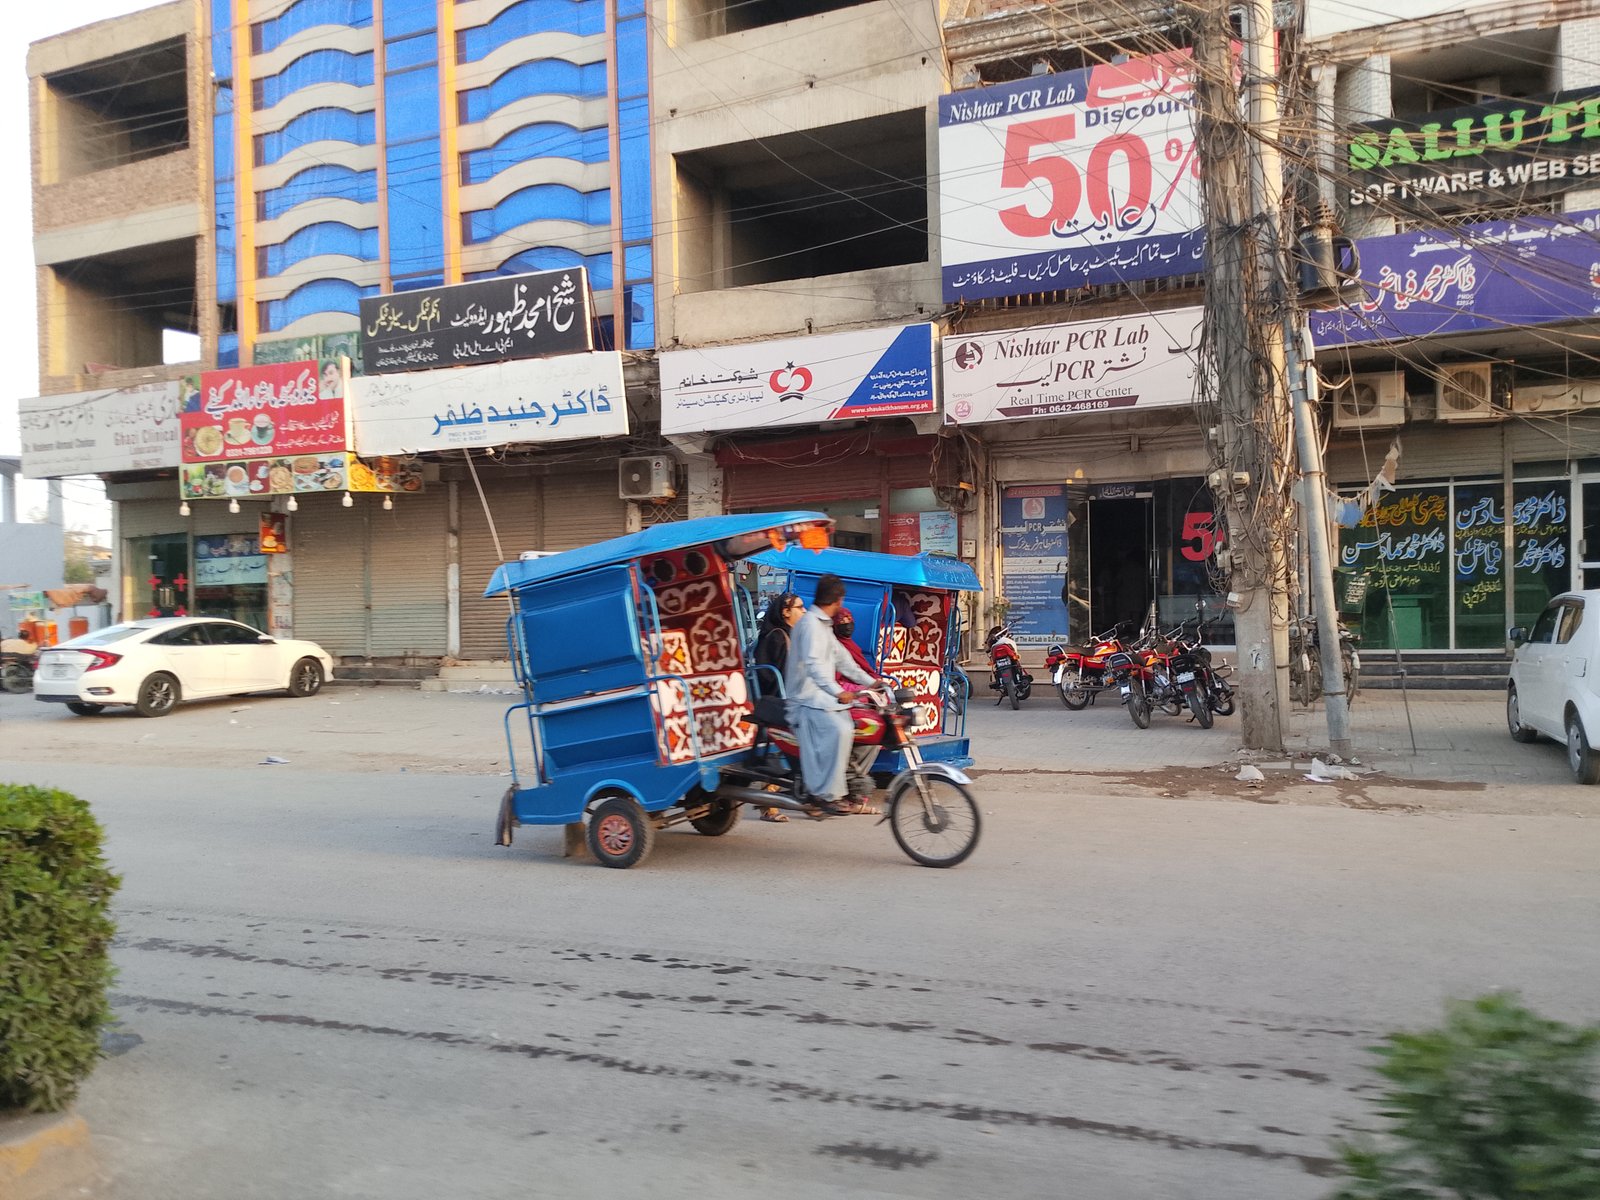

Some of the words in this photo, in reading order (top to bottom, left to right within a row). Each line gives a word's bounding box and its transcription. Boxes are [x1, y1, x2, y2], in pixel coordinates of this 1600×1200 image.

[948, 101, 1004, 123] Nishtar
[1006, 90, 1041, 114] PCR
[1046, 84, 1076, 106] Lab
[1350, 109, 1527, 170] SALLU
[1350, 170, 1484, 206] SOFTWARE
[1488, 168, 1506, 188] &
[1506, 160, 1567, 185] WEB
[1050, 188, 1158, 241] رعایت
[1408, 264, 1444, 303] محمد
[1433, 254, 1476, 302] ڈاکٹر
[482, 283, 529, 335] ظہور
[513, 295, 552, 339] امجد
[552, 274, 577, 333] شیخ
[995, 338, 1060, 360] Nishtar
[1066, 331, 1107, 351] PCR
[1113, 324, 1149, 346] Lab
[710, 368, 759, 384] شوکت
[996, 359, 1054, 393] لیب
[1054, 360, 1095, 382] PCR
[1095, 347, 1147, 383] نشتر
[486, 397, 547, 427] جنید
[549, 384, 612, 426] ڈاکٹر
[1010, 395, 1034, 406] Real
[1036, 393, 1064, 404] Time
[1067, 390, 1092, 401] PCR
[1096, 386, 1132, 398] Center
[1032, 406, 1047, 414] Ph:
[1049, 400, 1109, 413] 0642-468169
[432, 402, 483, 436] ظفر
[1029, 523, 1042, 531] PCR
[1529, 490, 1567, 529] ڈاکٹر
[1418, 526, 1446, 560] ڈاکٹر
[1532, 537, 1566, 574] ڈاکٹر
